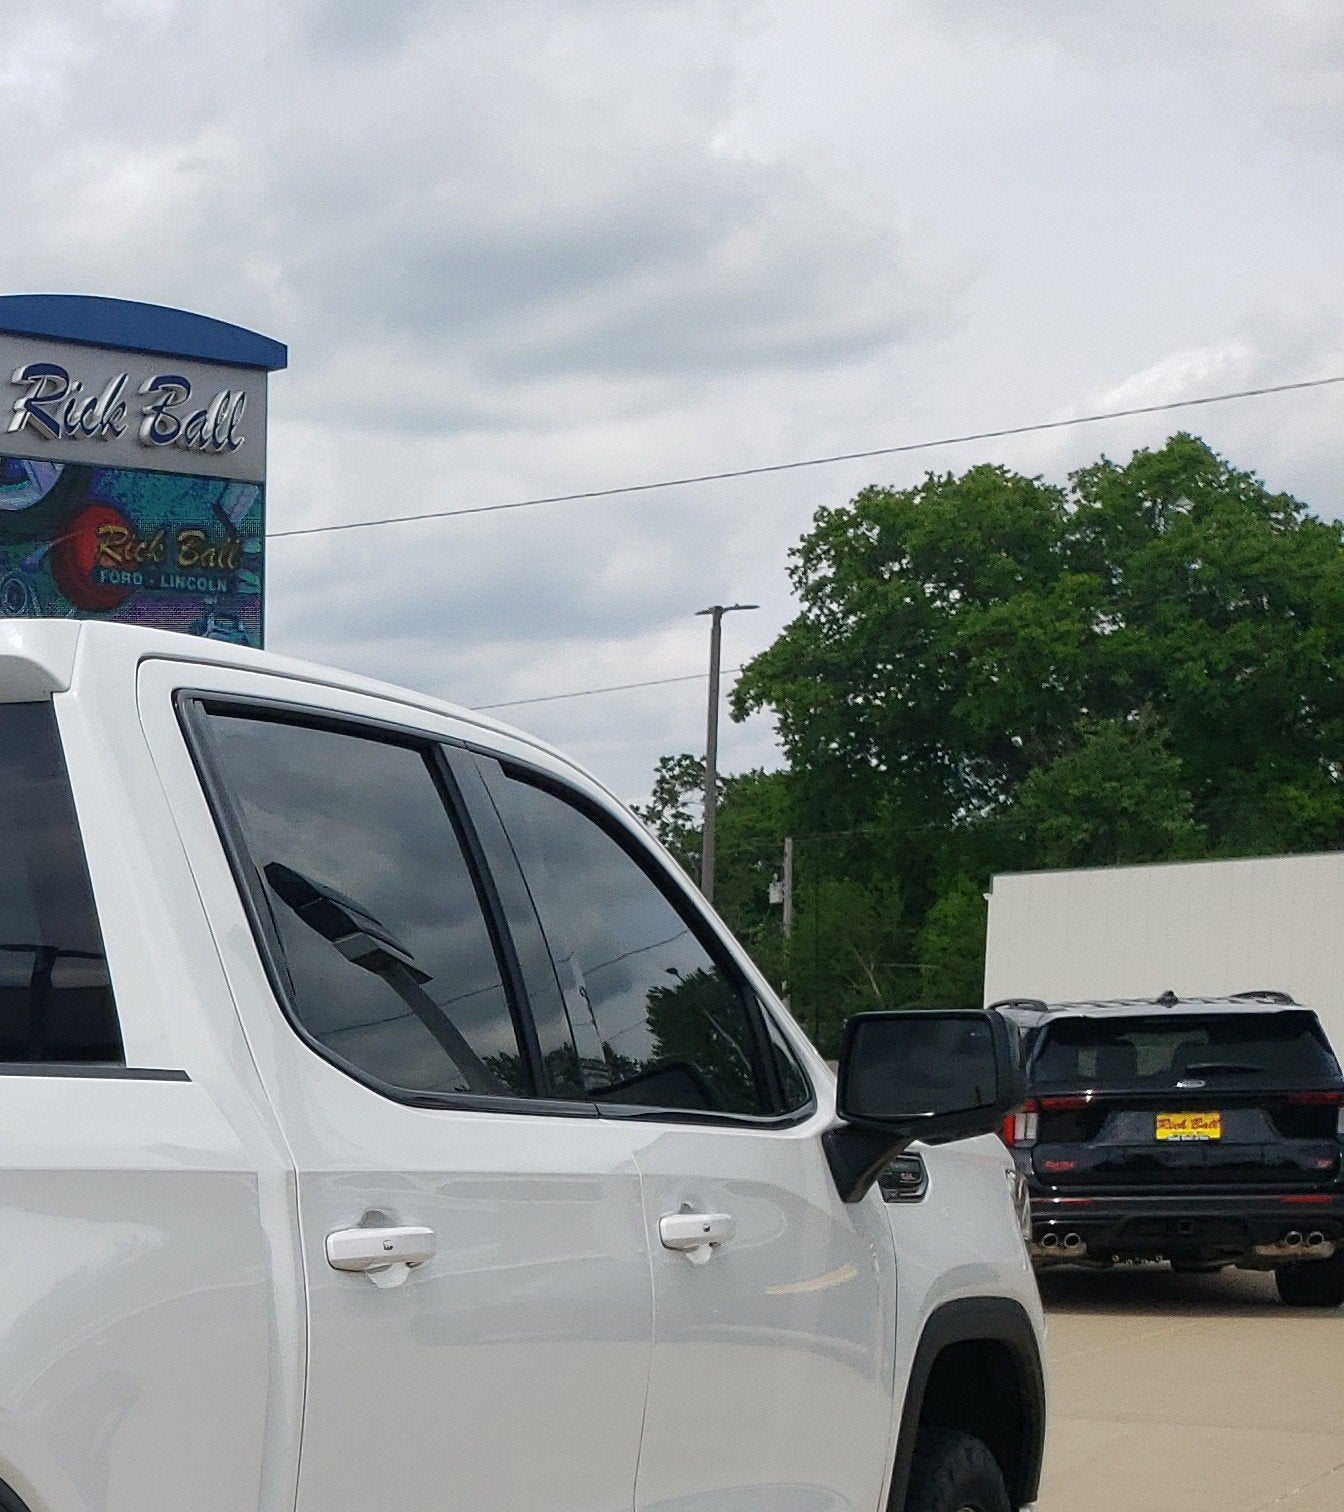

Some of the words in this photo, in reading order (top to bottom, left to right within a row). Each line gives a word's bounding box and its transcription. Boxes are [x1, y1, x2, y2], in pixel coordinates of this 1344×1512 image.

[7, 362, 130, 440] Rick
[138, 374, 247, 452] Ball
[97, 523, 165, 564] Rick
[178, 529, 241, 570] Ball
[99, 570, 143, 585] FORD
[161, 573, 228, 592] LINCOLN
